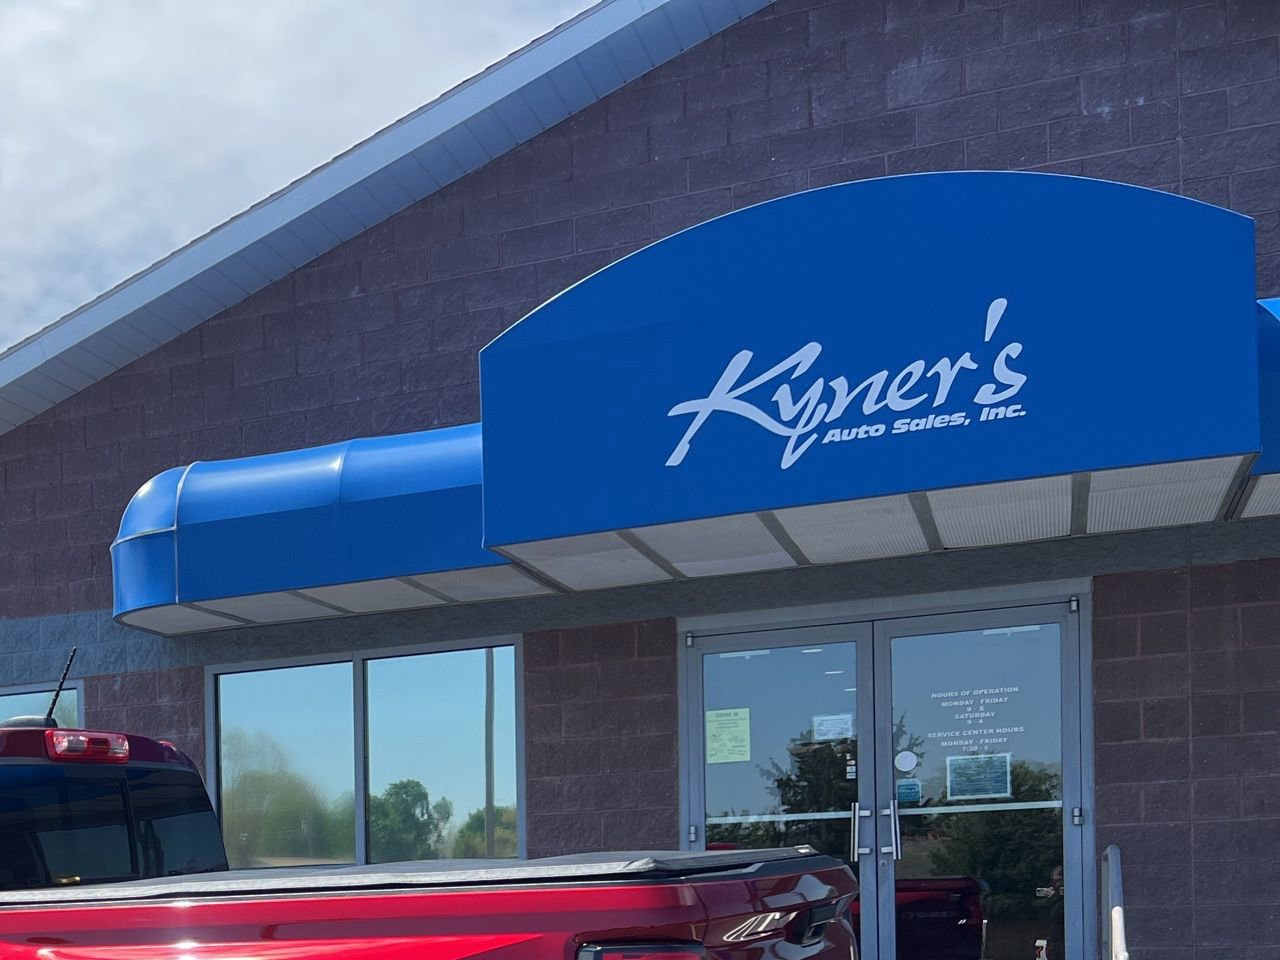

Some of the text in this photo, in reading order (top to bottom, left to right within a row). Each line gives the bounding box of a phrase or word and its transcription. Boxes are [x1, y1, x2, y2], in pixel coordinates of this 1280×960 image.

[665, 297, 1028, 470] Kyner's
[822, 404, 1027, 444] Auto Sales, Inc.
[973, 687, 1019, 695] OPERATION
[954, 711, 996, 719] SATURDAY
[962, 728, 994, 736] CENTER
[996, 726, 1024, 734] HOURS
[941, 739, 974, 747] MONDAY
